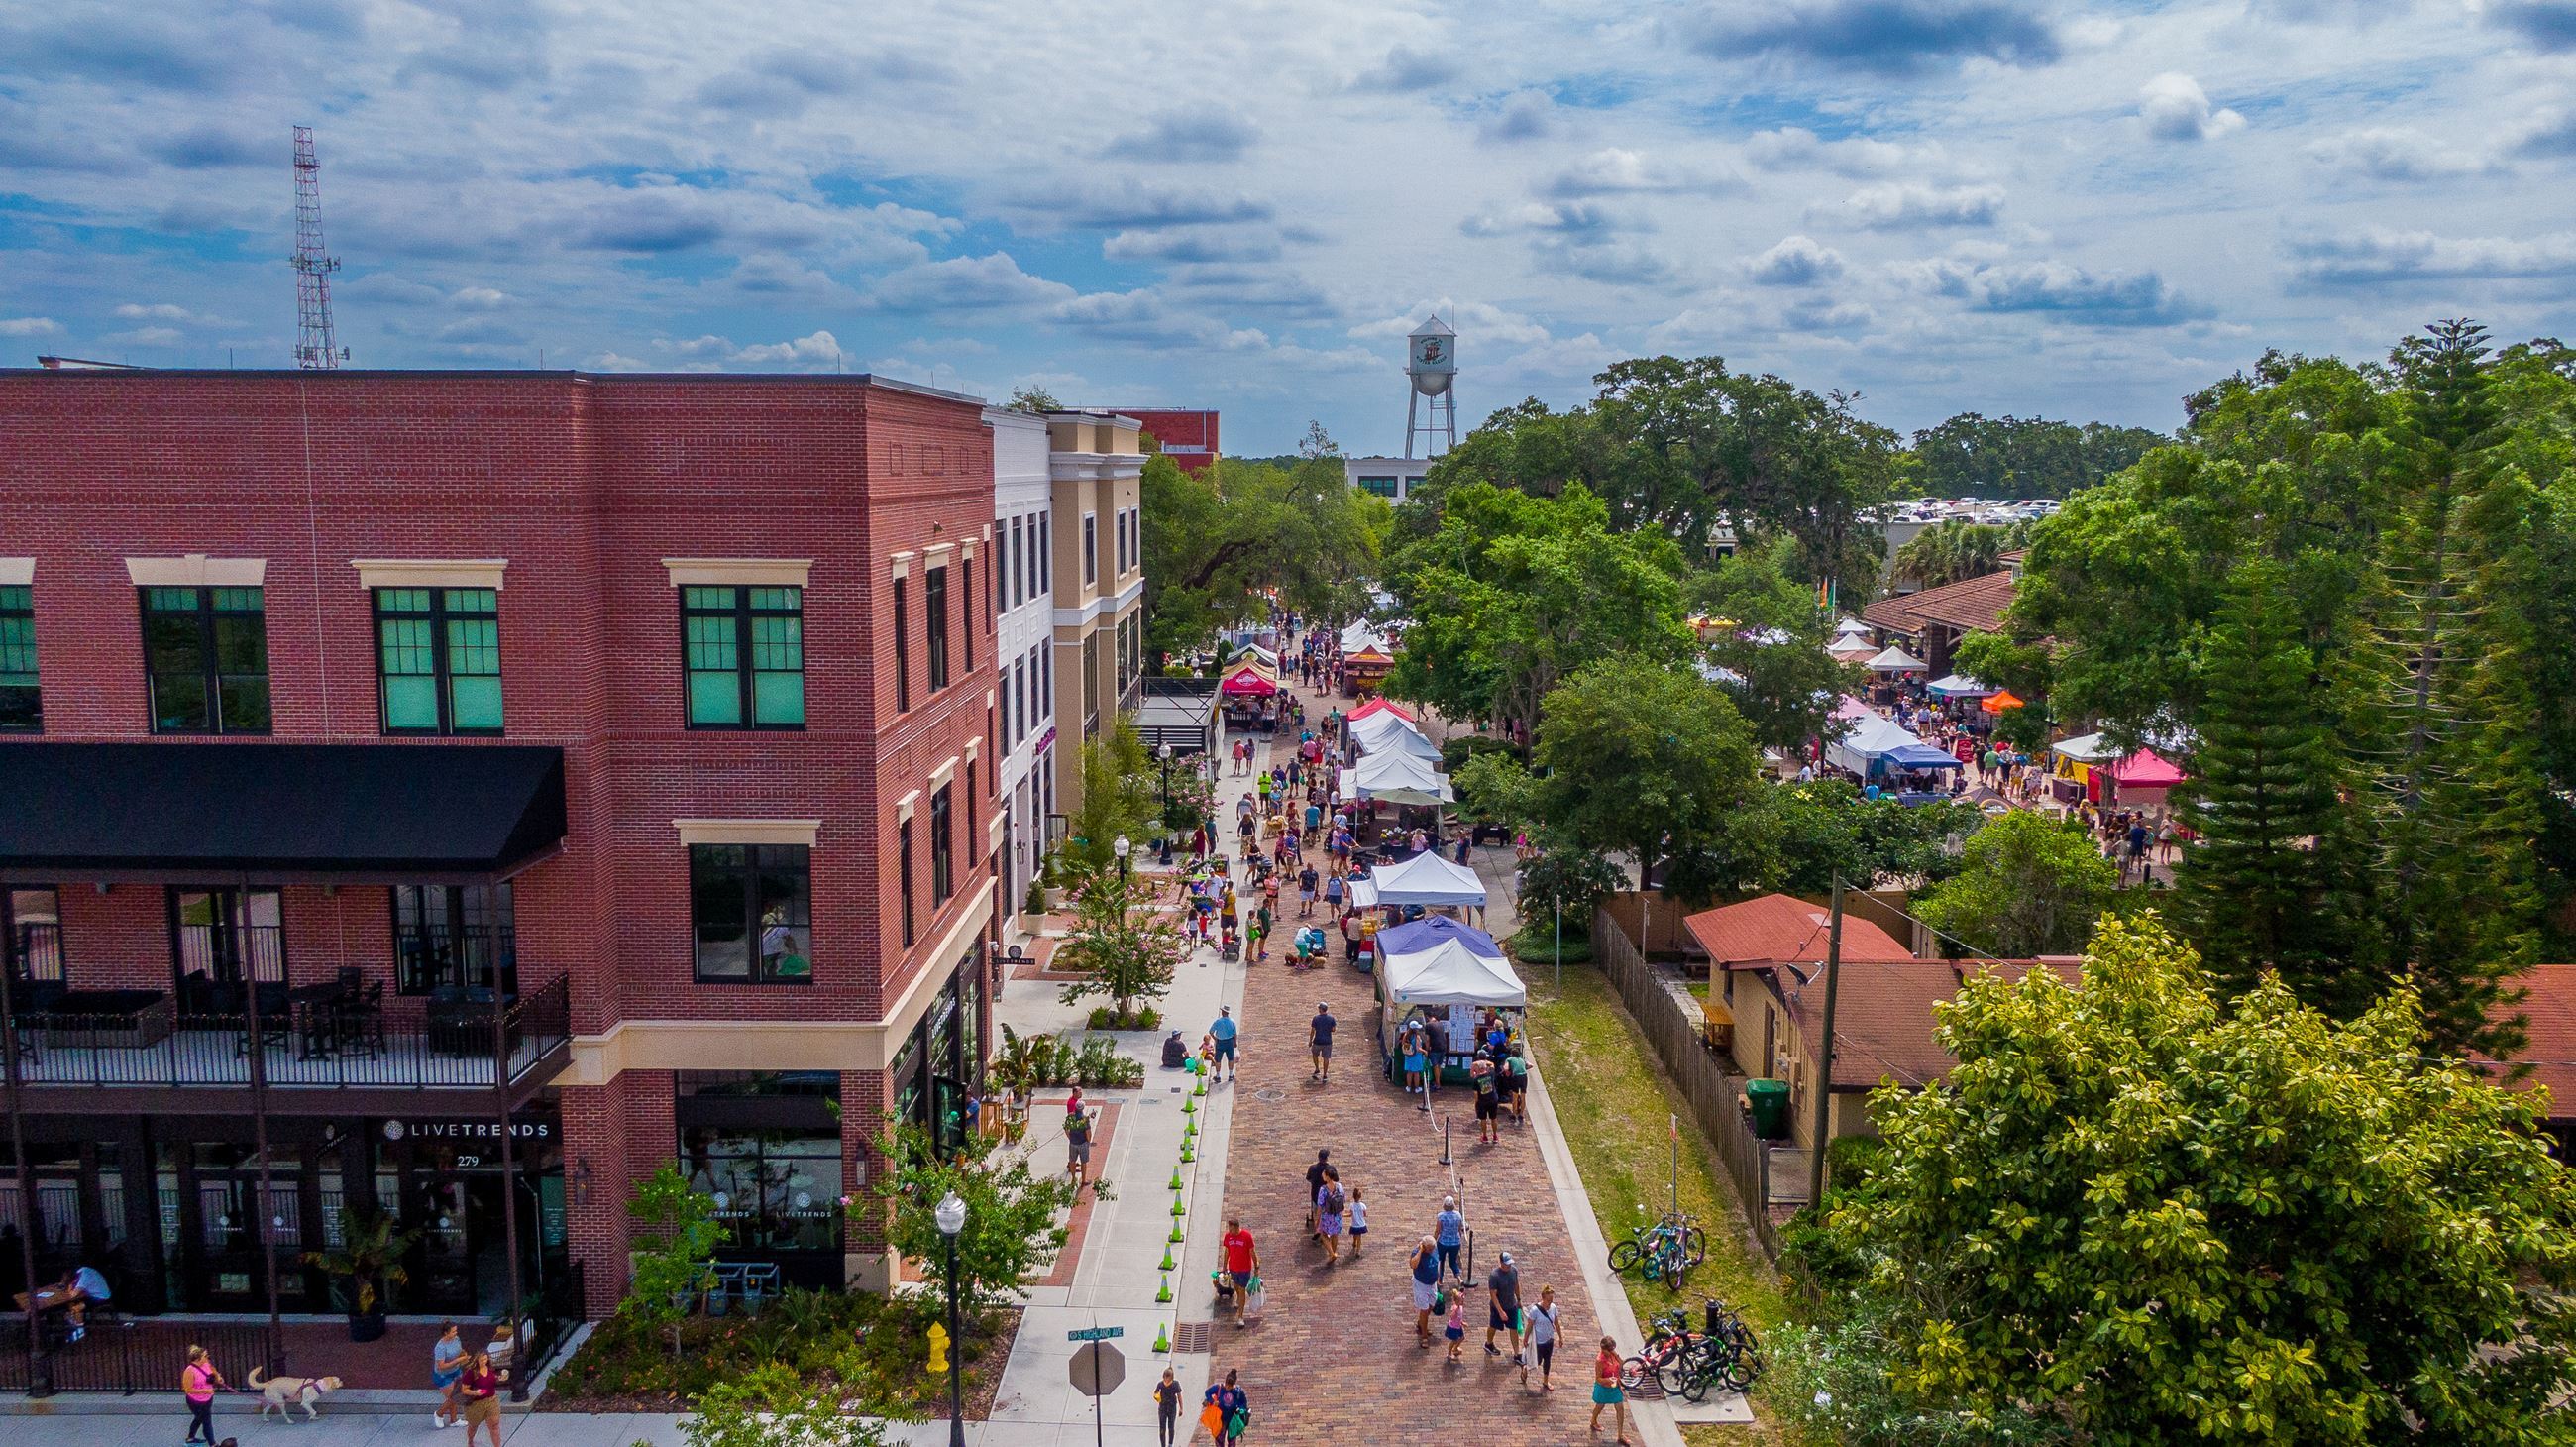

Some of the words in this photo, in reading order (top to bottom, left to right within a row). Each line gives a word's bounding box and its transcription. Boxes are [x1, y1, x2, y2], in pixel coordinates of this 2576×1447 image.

[411, 1124, 549, 1137] LIVETRENDS
[458, 1156, 480, 1167] 279
[1077, 1331, 1082, 1340] S
[1083, 1329, 1111, 1339] HIGHLAND
[1112, 1327, 1123, 1336] AVE
